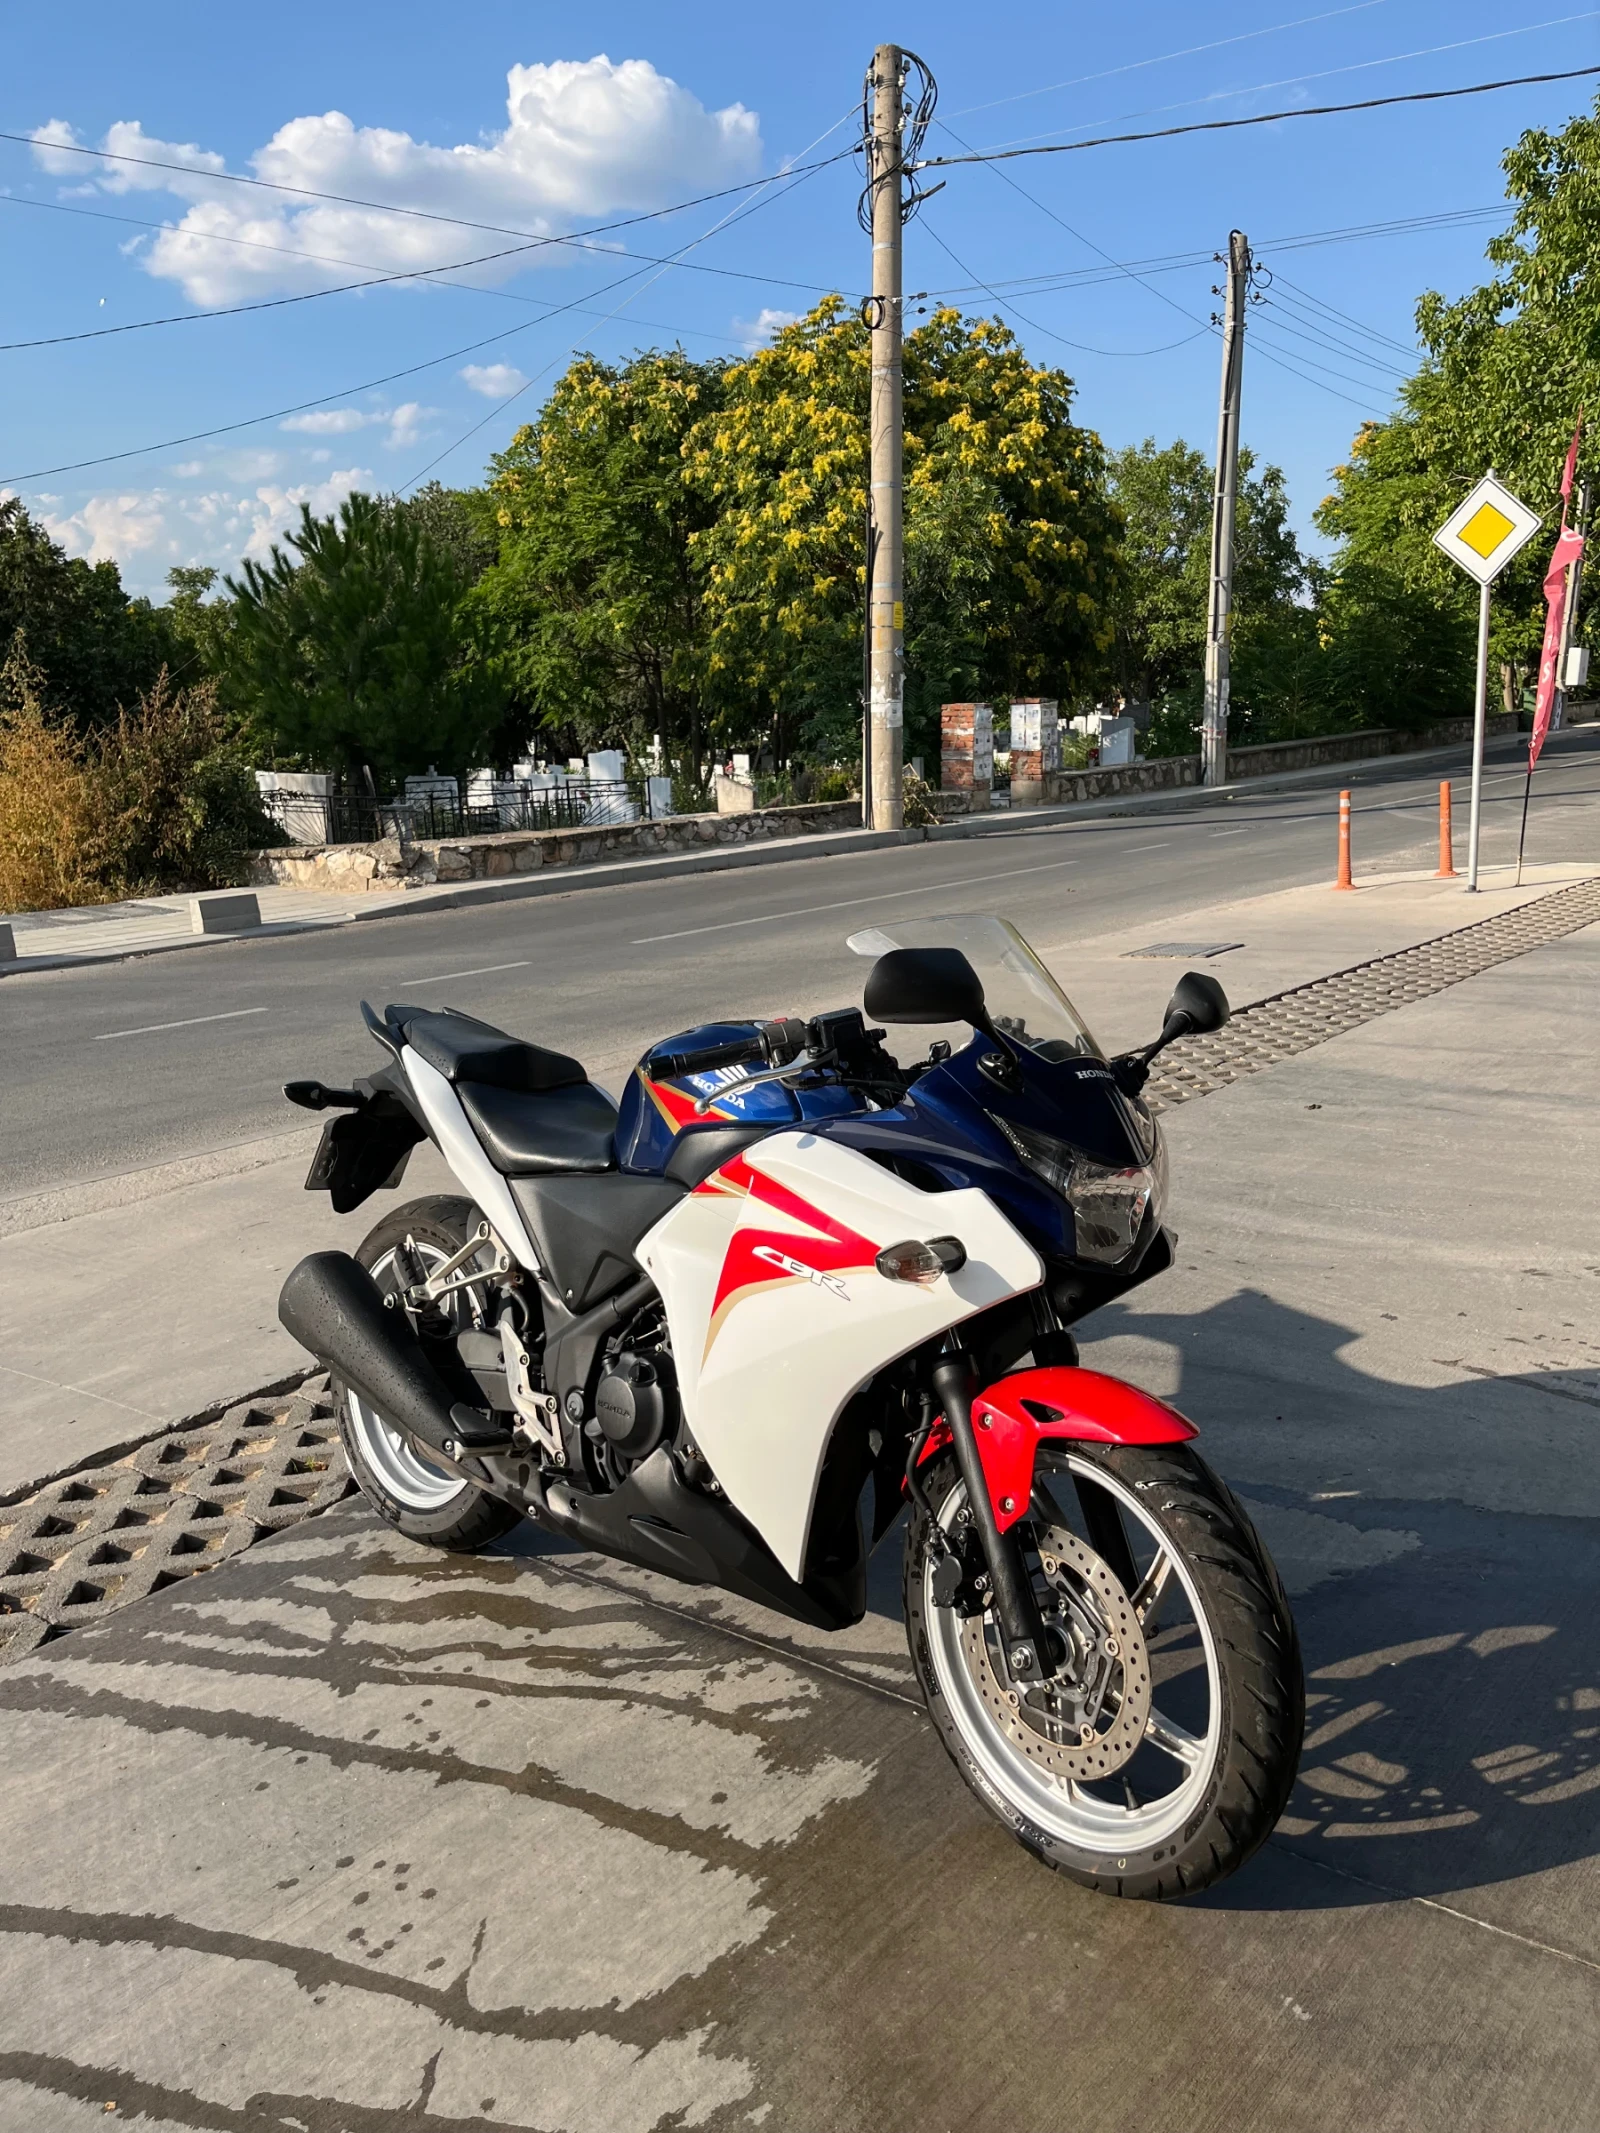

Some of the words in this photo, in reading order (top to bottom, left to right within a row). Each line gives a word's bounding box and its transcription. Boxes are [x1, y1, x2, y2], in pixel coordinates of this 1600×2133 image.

[1075, 1069, 1115, 1081] HONDA
[752, 1245, 851, 1302] CBR
[597, 1400, 632, 1419] HONDA
